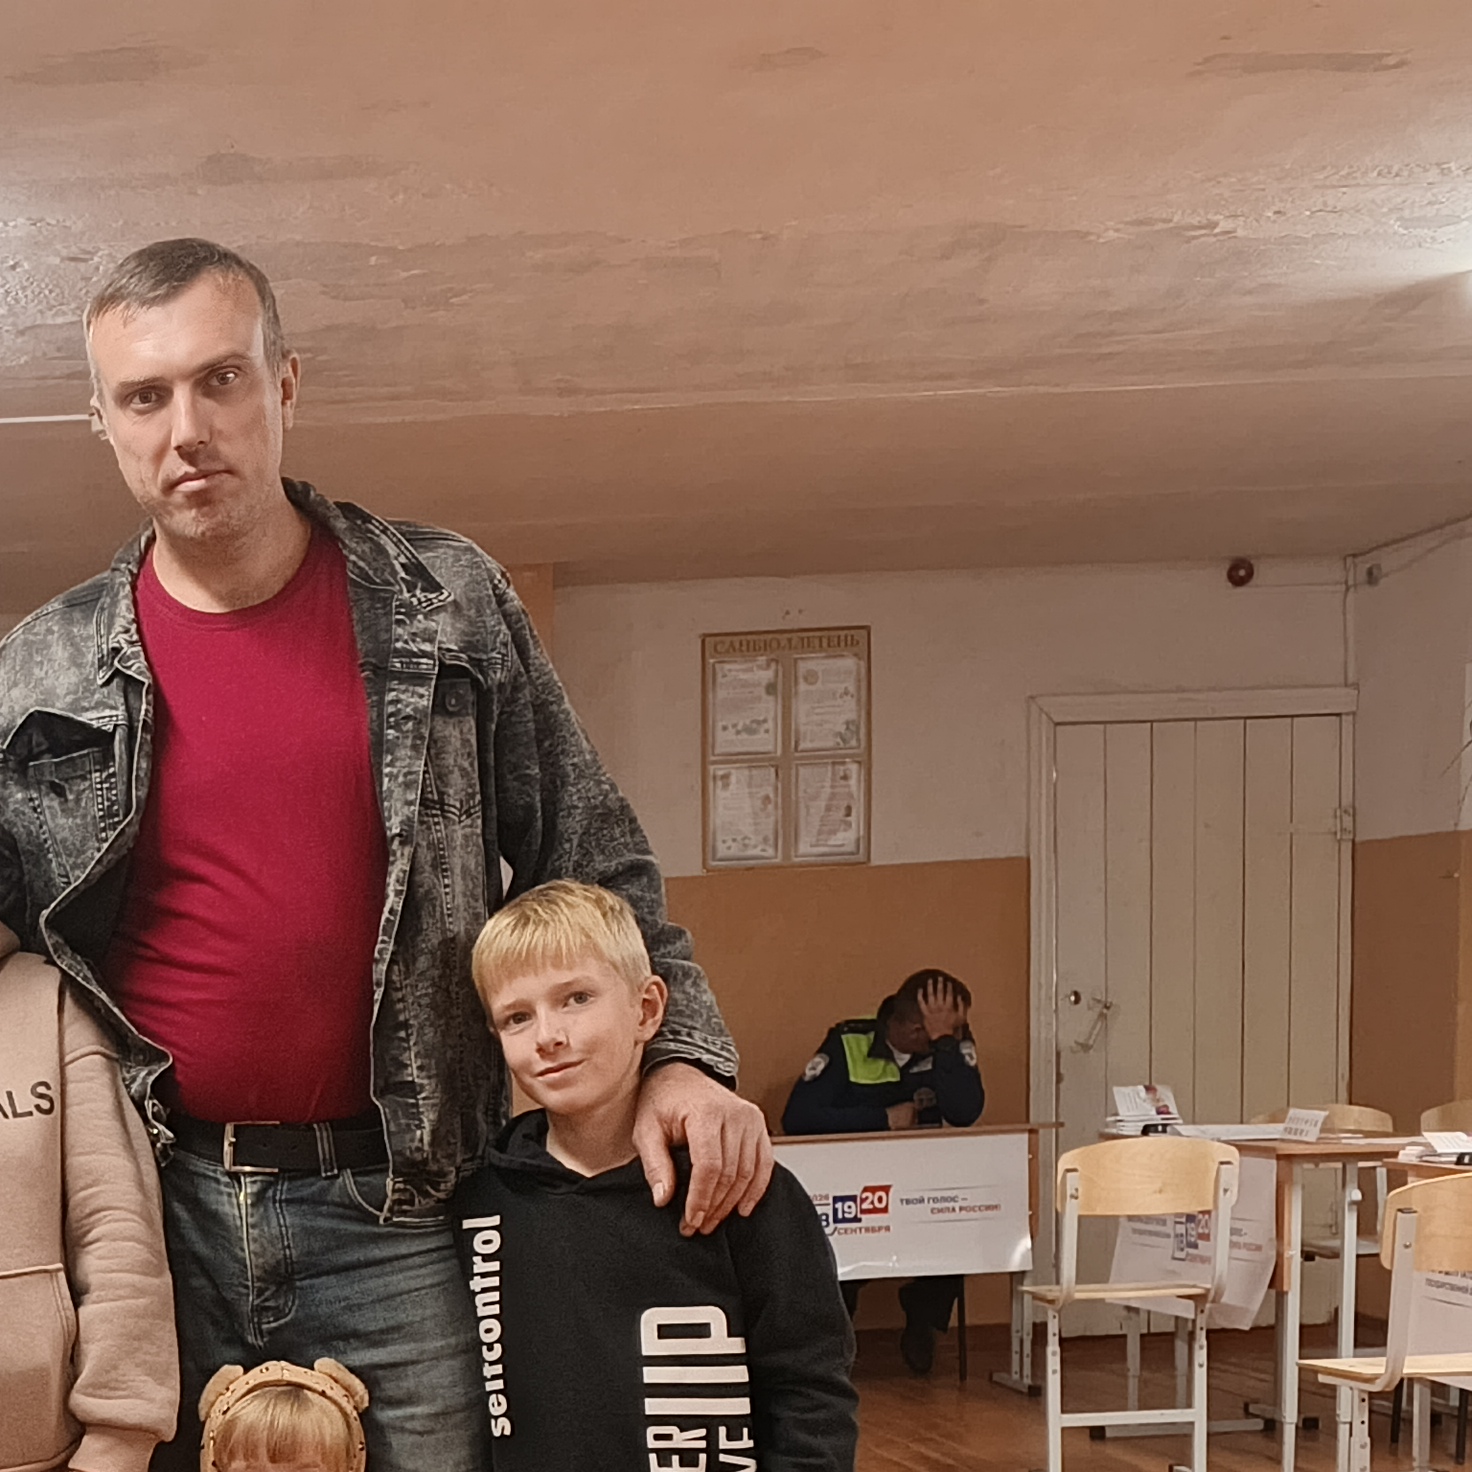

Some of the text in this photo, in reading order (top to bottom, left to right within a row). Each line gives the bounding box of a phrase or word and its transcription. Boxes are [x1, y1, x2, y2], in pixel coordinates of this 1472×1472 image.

[835, 1202, 857, 1218] 19
[861, 1191, 887, 1209] 20
[900, 1196, 925, 1206] ТВОЙ
[927, 1195, 959, 1204] ГОЛОС
[837, 1225, 891, 1235] СЕНТЯБРЯ
